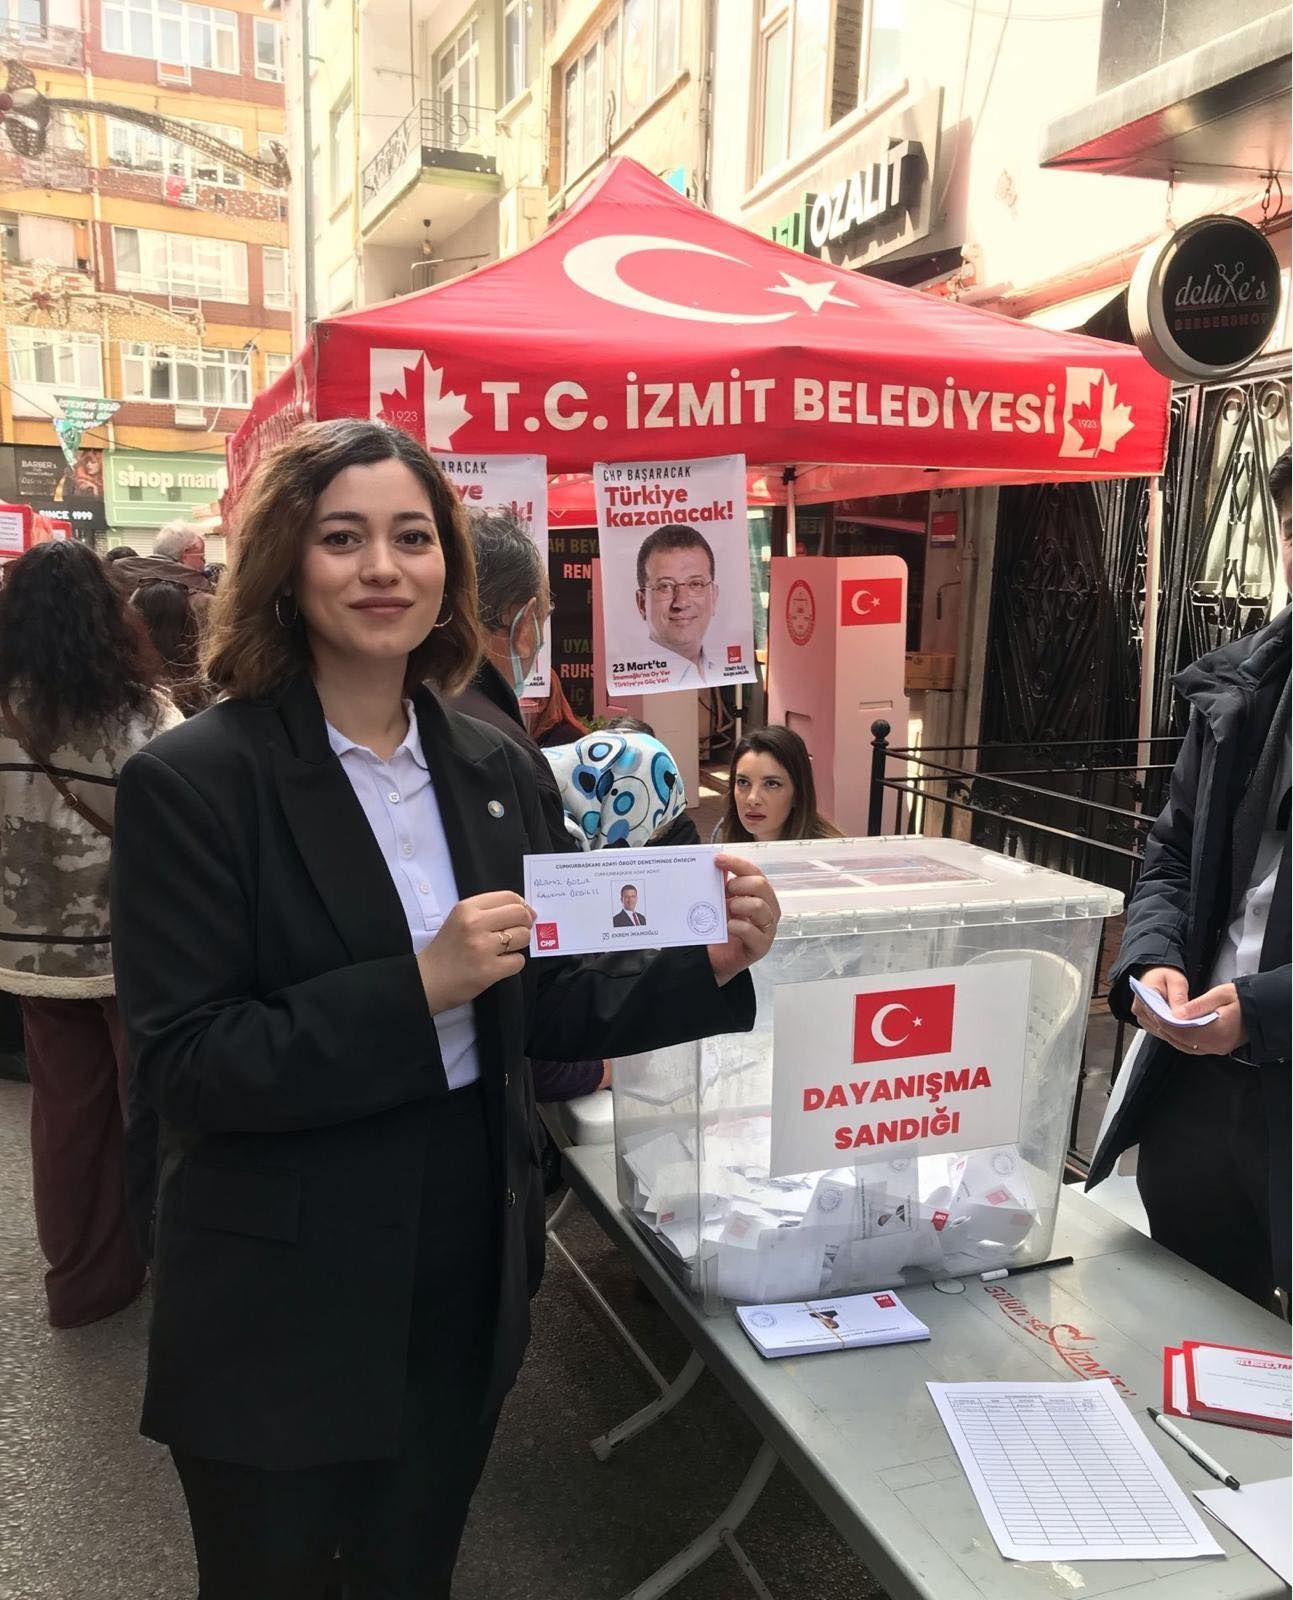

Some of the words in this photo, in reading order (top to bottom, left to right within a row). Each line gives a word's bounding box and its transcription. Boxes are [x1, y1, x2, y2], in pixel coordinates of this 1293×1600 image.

[810, 137, 909, 248] OZALİT
[481, 381, 608, 432] T.C.
[626, 368, 776, 429] İZMİT
[793, 376, 1056, 435] BELEDİYESİ
[390, 411, 418, 423] 1923
[1077, 418, 1098, 430] 1923
[118, 465, 174, 495] sinop
[603, 469, 623, 482] CHP
[627, 466, 692, 482] BAŞARACAK
[604, 484, 689, 509] Türkiye
[72, 511, 93, 520] 1999
[606, 501, 733, 528] kazanacak!
[612, 663, 625, 673] 23
[627, 660, 667, 671] Mart'ta
[803, 1066, 991, 1112] DAYANIŞMA
[834, 1105, 960, 1150] SANDIĞI
